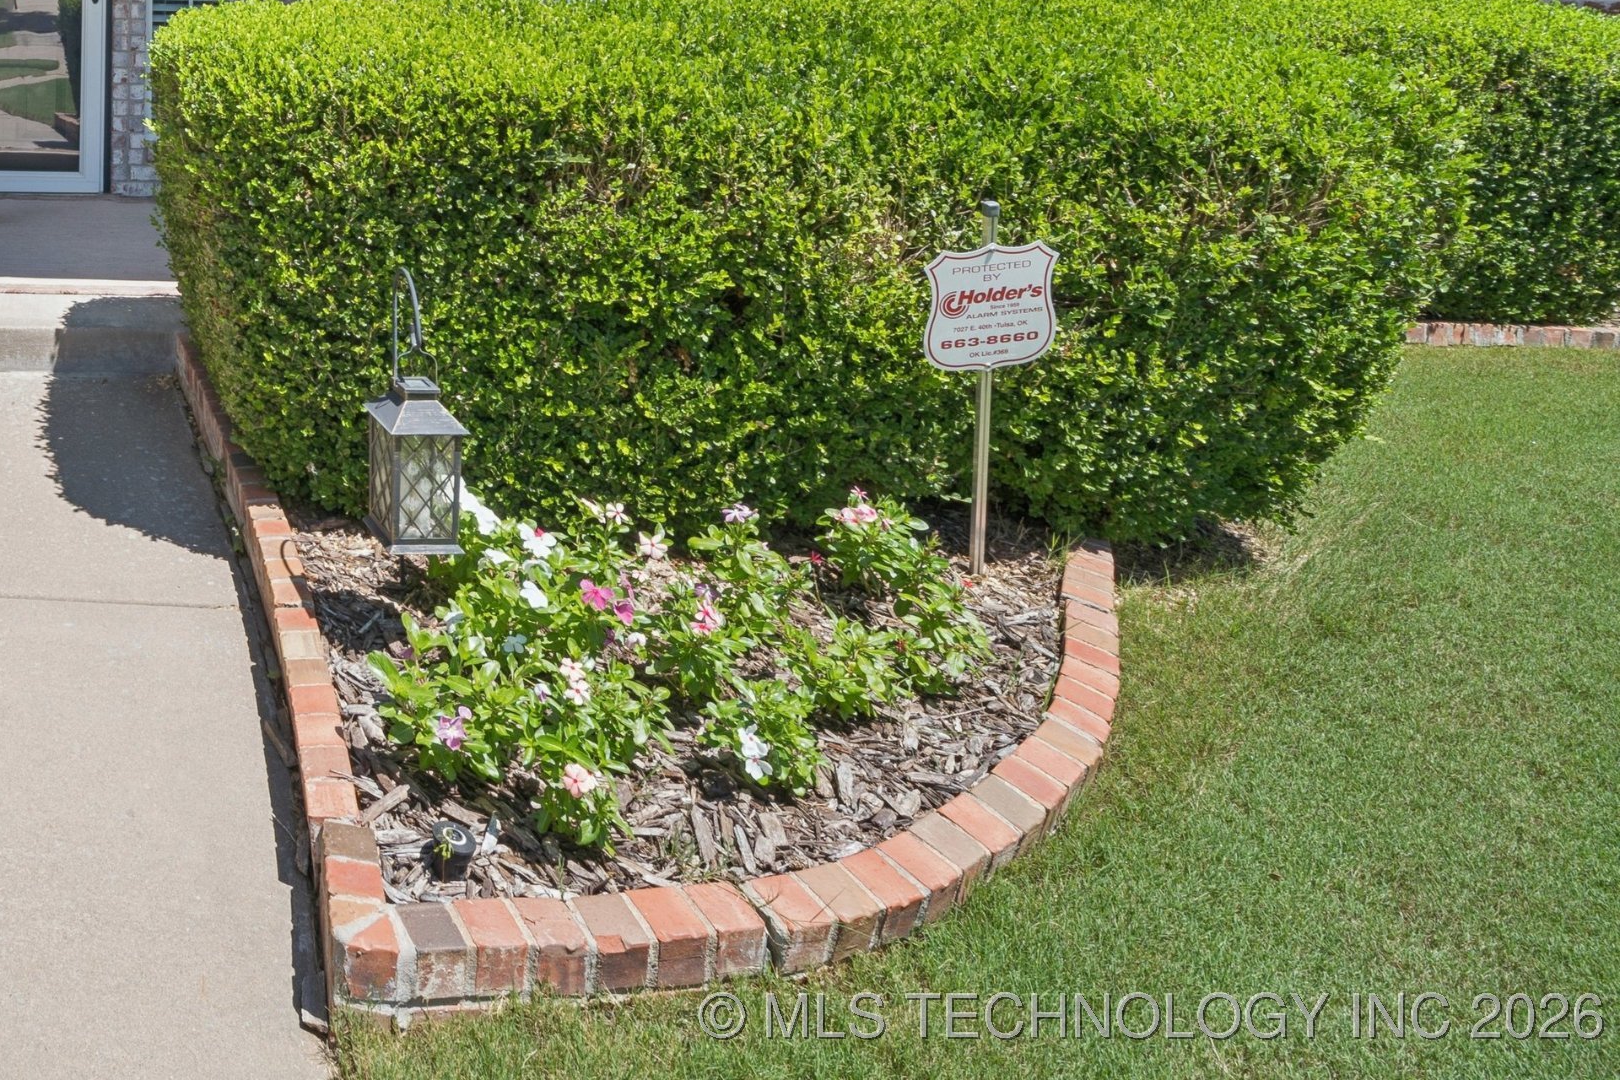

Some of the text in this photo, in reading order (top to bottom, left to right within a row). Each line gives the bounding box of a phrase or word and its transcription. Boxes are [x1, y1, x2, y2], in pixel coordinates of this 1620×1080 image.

[952, 259, 1032, 275] PROTECTED
[983, 273, 1001, 282] BY
[958, 284, 1043, 306] Holder's
[966, 306, 1043, 319] ALARM SYSTEMS
[941, 331, 1039, 350] 663-8660
